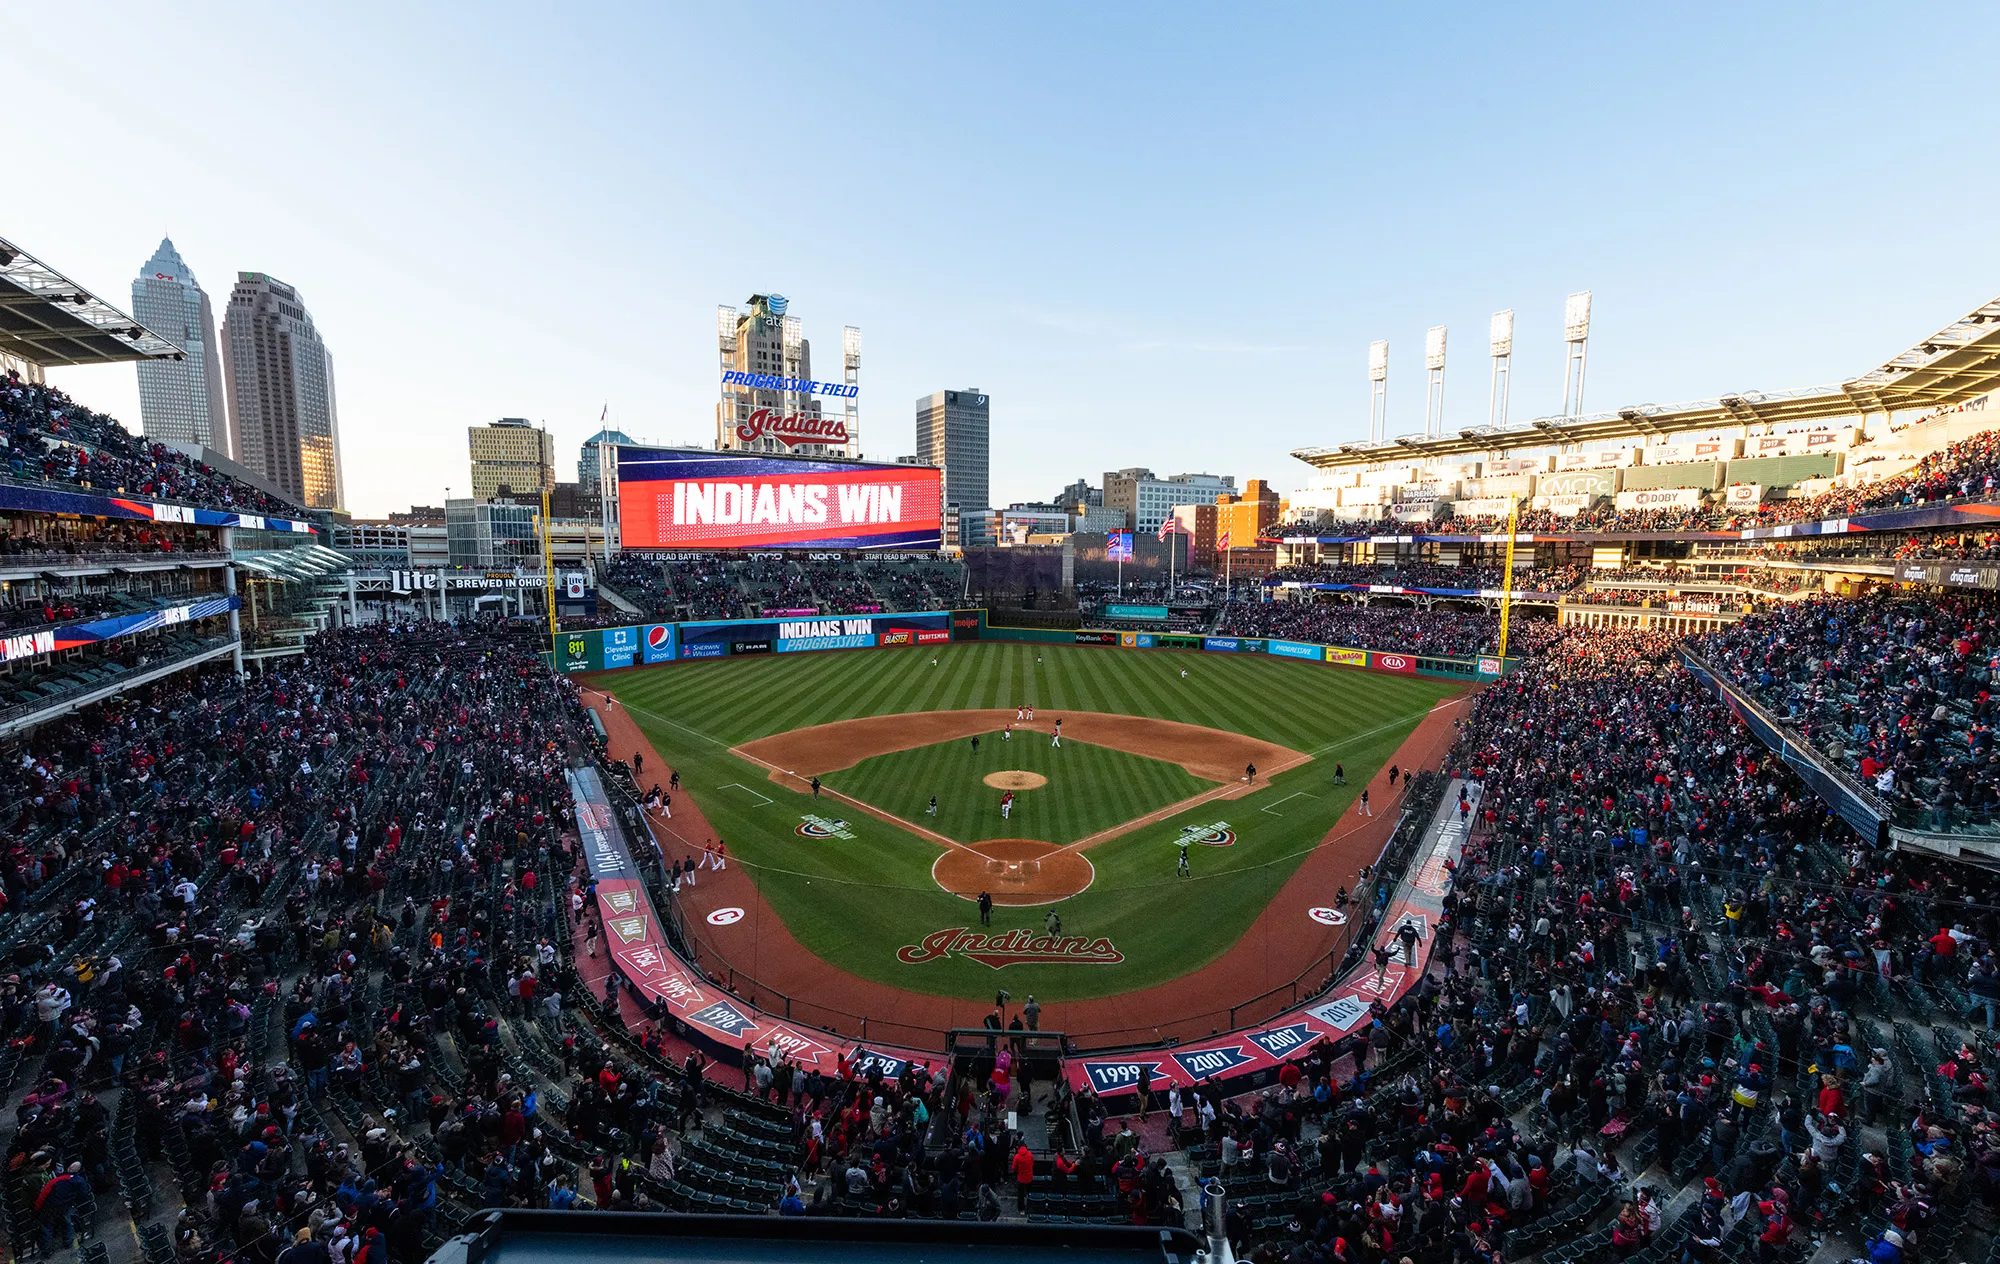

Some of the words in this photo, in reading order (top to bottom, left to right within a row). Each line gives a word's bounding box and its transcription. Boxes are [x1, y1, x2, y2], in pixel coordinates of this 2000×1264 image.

[765, 315, 784, 327] at&
[722, 371, 819, 394] PROGRESSIVE
[821, 383, 859, 398] FIELD
[976, 395, 986, 407] 9
[736, 408, 849, 446] Indians
[1762, 440, 1779, 448] 2017
[1810, 436, 1828, 444] 2018
[673, 482, 828, 525] INDIANS
[838, 485, 902, 523] WIN
[1553, 497, 1584, 506] THOME
[1650, 493, 1679, 503] DOBY
[1478, 502, 1505, 510] LEMON
[656, 553, 677, 561] DEAD
[865, 553, 883, 561] START
[883, 553, 899, 561] DEAD
[390, 570, 437, 595] Lite
[456, 578, 503, 588] BREWED
[505, 578, 516, 588] IN
[518, 578, 543, 588] OHIO
[568, 577, 584, 586] Lite
[1979, 568, 1998, 588] CLUB
[1668, 601, 1684, 612] THE
[1684, 601, 1721, 614] CORNER
[779, 620, 841, 639] INDIANS
[843, 618, 873, 636] WIN
[954, 617, 978, 629] meijer
[918, 632, 949, 641] CRAFTSMAN
[1075, 634, 1102, 643] KeyBank
[1, 633, 35, 661] DIANS
[569, 640, 585, 654] 811
[605, 643, 637, 654] Cleveland
[785, 635, 866, 651] PROGRESSIVE
[1206, 639, 1237, 649] FirstEnergy
[651, 651, 670, 661] pepsi
[1275, 644, 1313, 656] PROGRESSIVE
[612, 653, 631, 662] Clinic
[1385, 658, 1402, 666] KIA
[1480, 658, 1497, 669] drug
[896, 926, 1125, 970] Indians
[630, 947, 660, 968] 1954
[658, 977, 693, 998] 1995
[704, 1006, 743, 1030] 1996
[1321, 1000, 1360, 1024] 2013
[1259, 1028, 1303, 1052] 2007
[861, 1055, 898, 1075] 98
[1185, 1050, 1235, 1074] 2001
[1095, 1064, 1142, 1085] 1999
